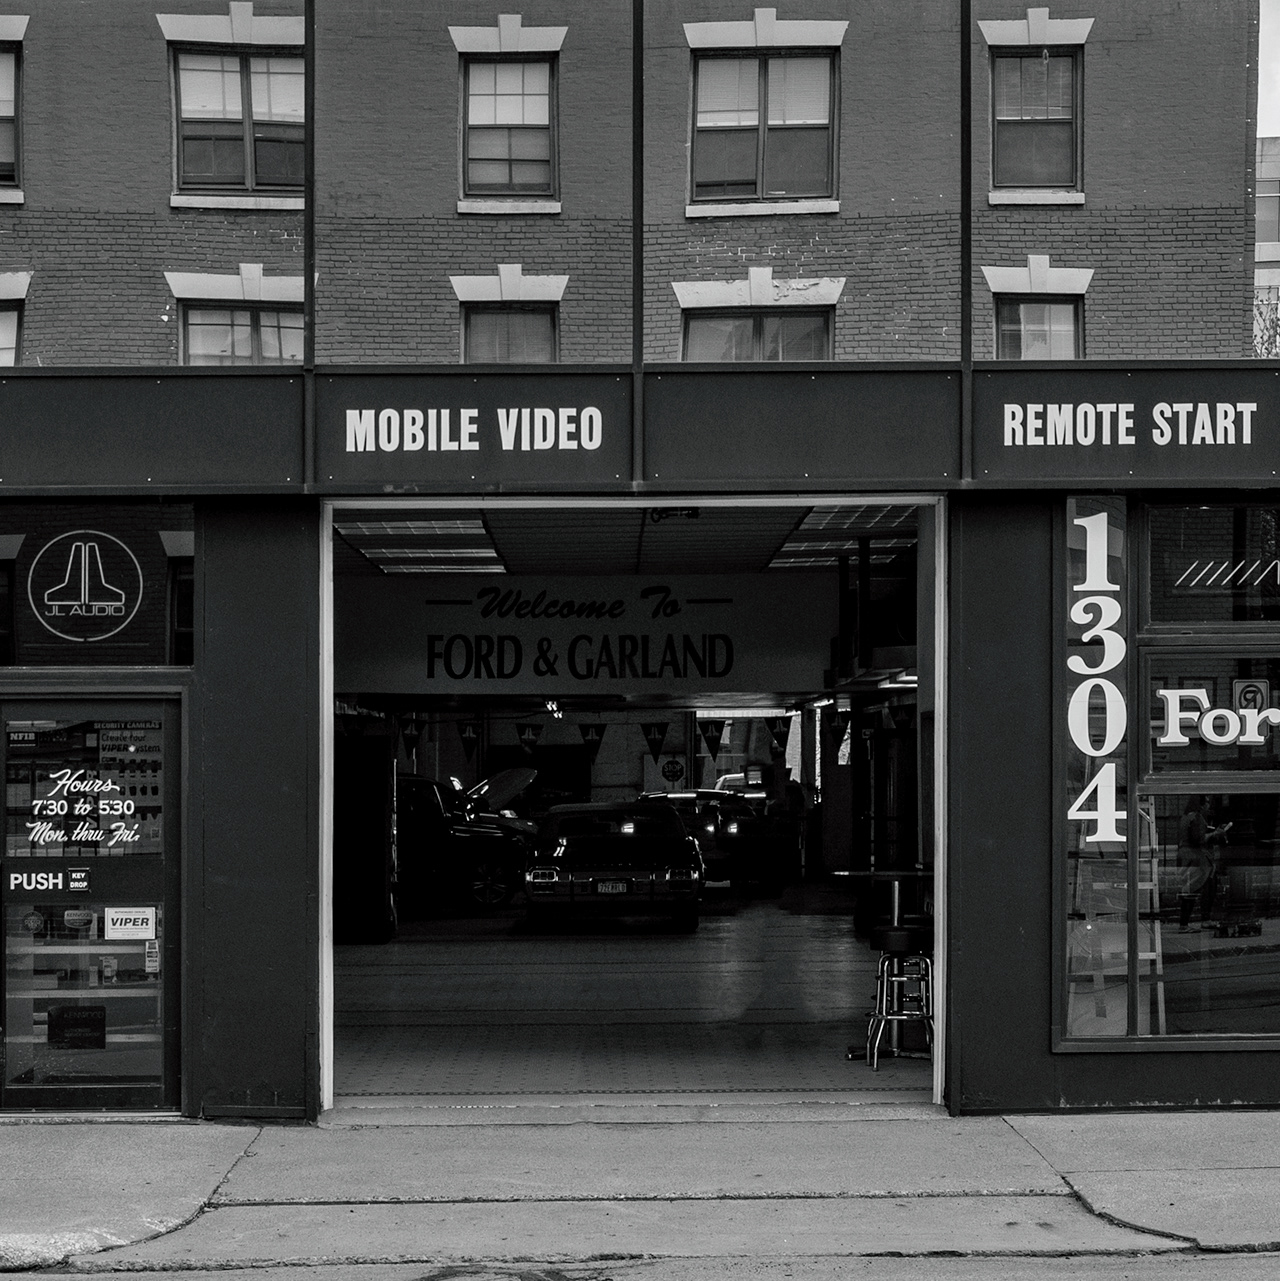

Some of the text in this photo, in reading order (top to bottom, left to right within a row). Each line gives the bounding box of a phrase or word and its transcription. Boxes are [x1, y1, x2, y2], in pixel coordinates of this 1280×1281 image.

[345, 407, 603, 452] MOBILE VIDEO
[1003, 403, 1257, 446] REMOTE START
[45, 605, 125, 617] JL AUDIO
[476, 585, 682, 619] Welcome To
[426, 633, 734, 680] FORD & GARLAND
[1067, 512, 1127, 842] 1304
[47, 769, 120, 796] Hours
[32, 798, 135, 816] 7:30 to 5:30
[25, 821, 140, 846] Mon. thru Fri.
[10, 873, 63, 890] PUSH
[111, 918, 150, 927] VIPER
